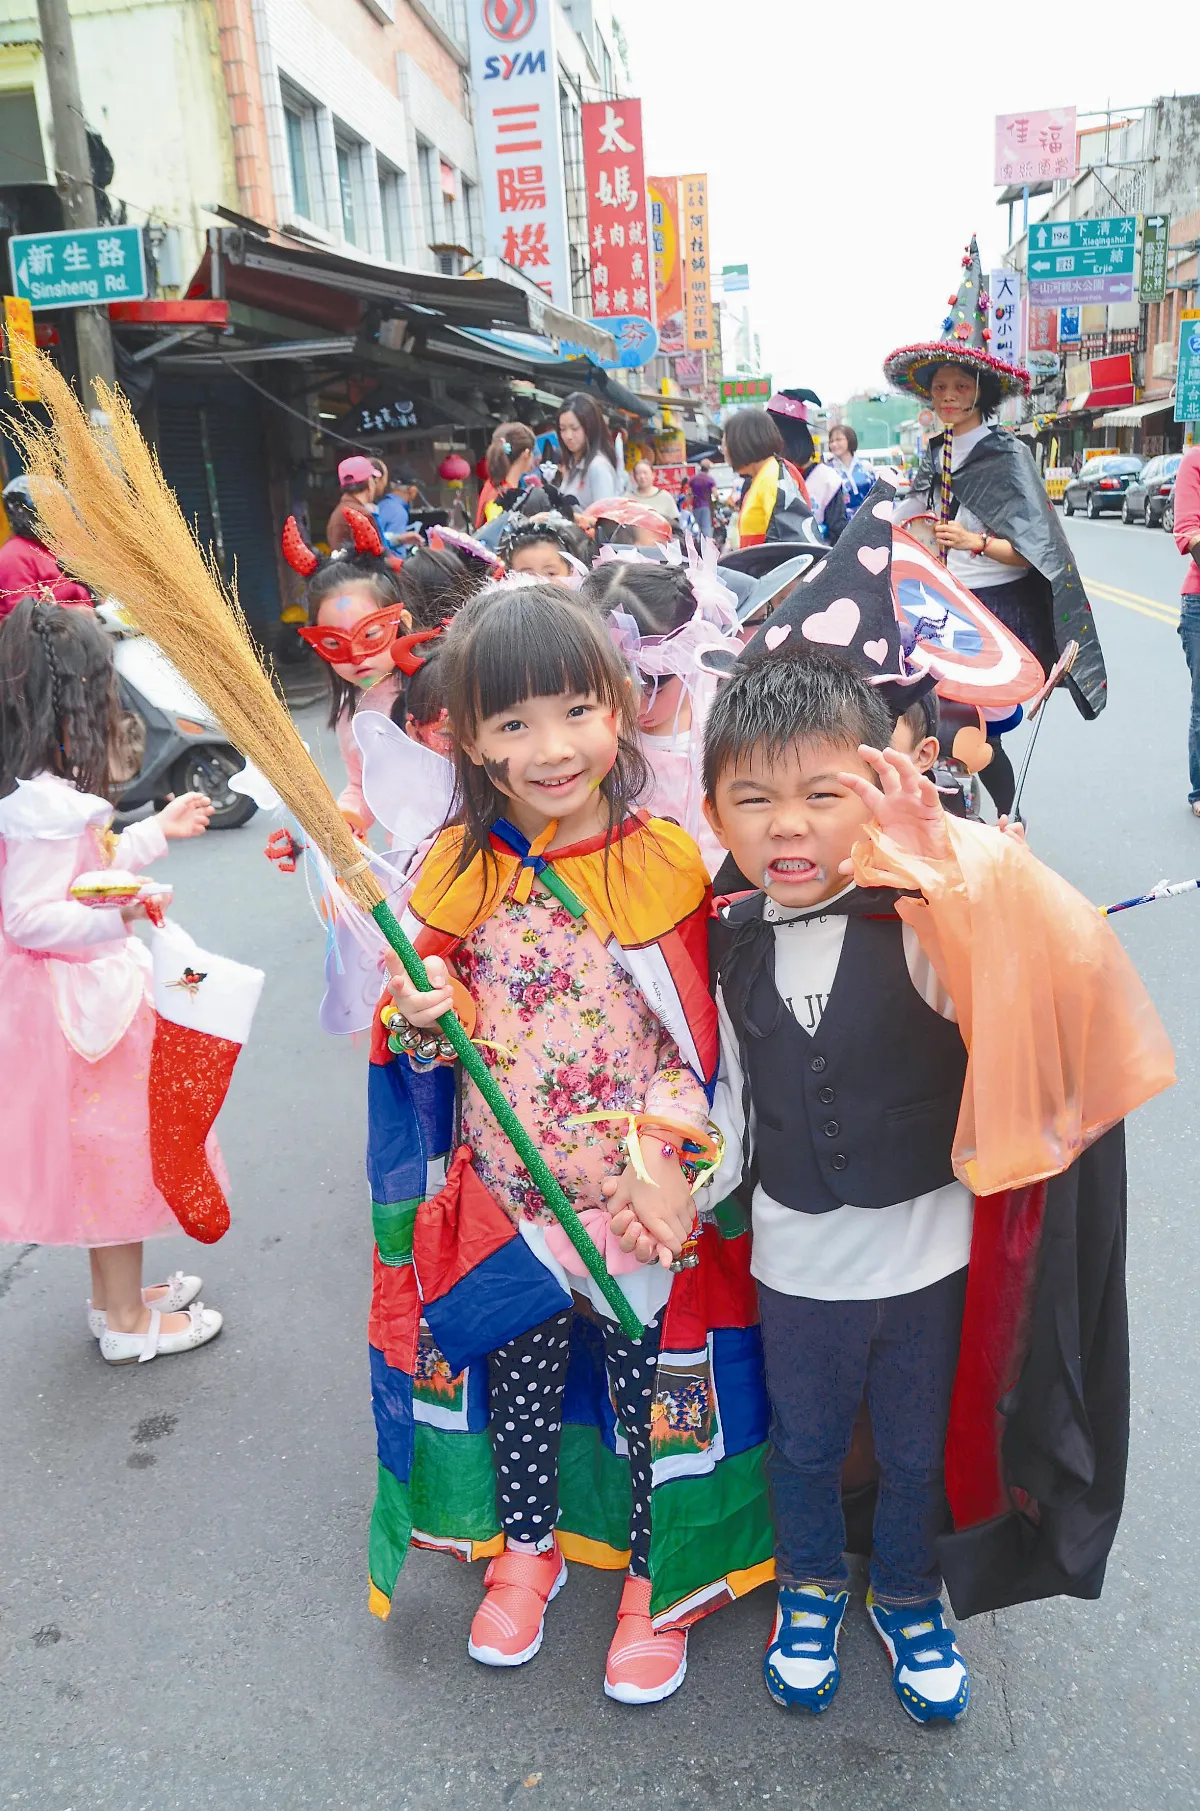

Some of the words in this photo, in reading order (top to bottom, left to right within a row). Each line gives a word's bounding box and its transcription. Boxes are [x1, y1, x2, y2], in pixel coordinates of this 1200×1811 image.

[483, 50, 546, 80] SYM
[1006, 118, 1063, 153] 佳福
[594, 104, 640, 213] 太媽
[1053, 232, 1069, 241] 196
[1075, 219, 1133, 237] 下清水
[27, 237, 126, 276] 新生路
[1082, 248, 1124, 263] 二結
[1093, 264, 1114, 276] Erjie
[30, 279, 99, 299] Sinsheng
[104, 273, 129, 292] Rd.
